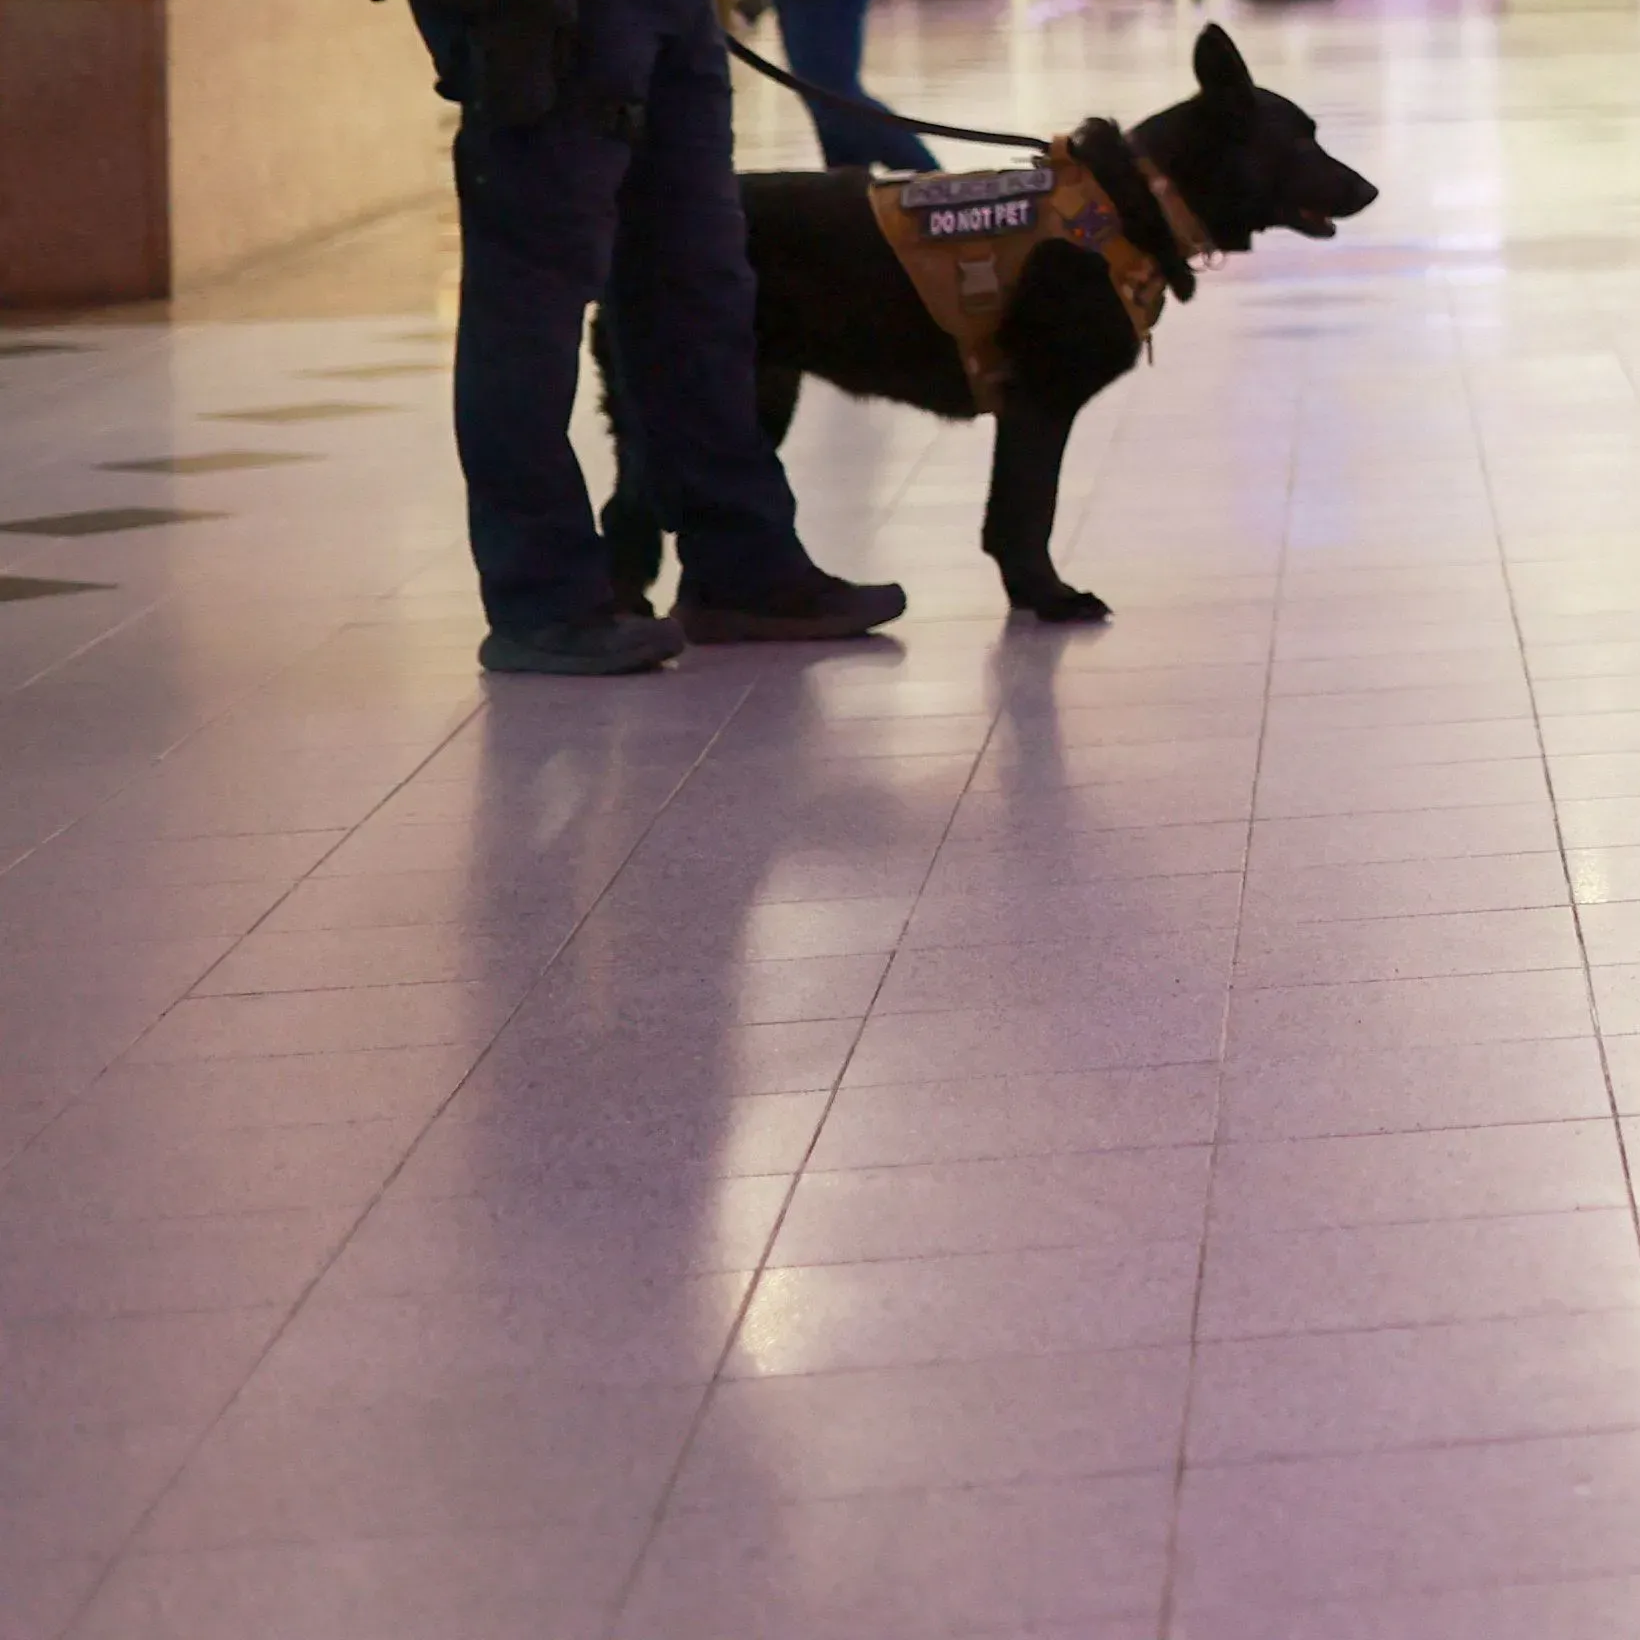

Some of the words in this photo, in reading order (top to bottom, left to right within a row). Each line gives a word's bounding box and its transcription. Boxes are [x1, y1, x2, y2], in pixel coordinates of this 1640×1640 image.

[930, 211, 957, 235] DO
[957, 207, 992, 232] NOT
[995, 200, 1029, 229] PET
